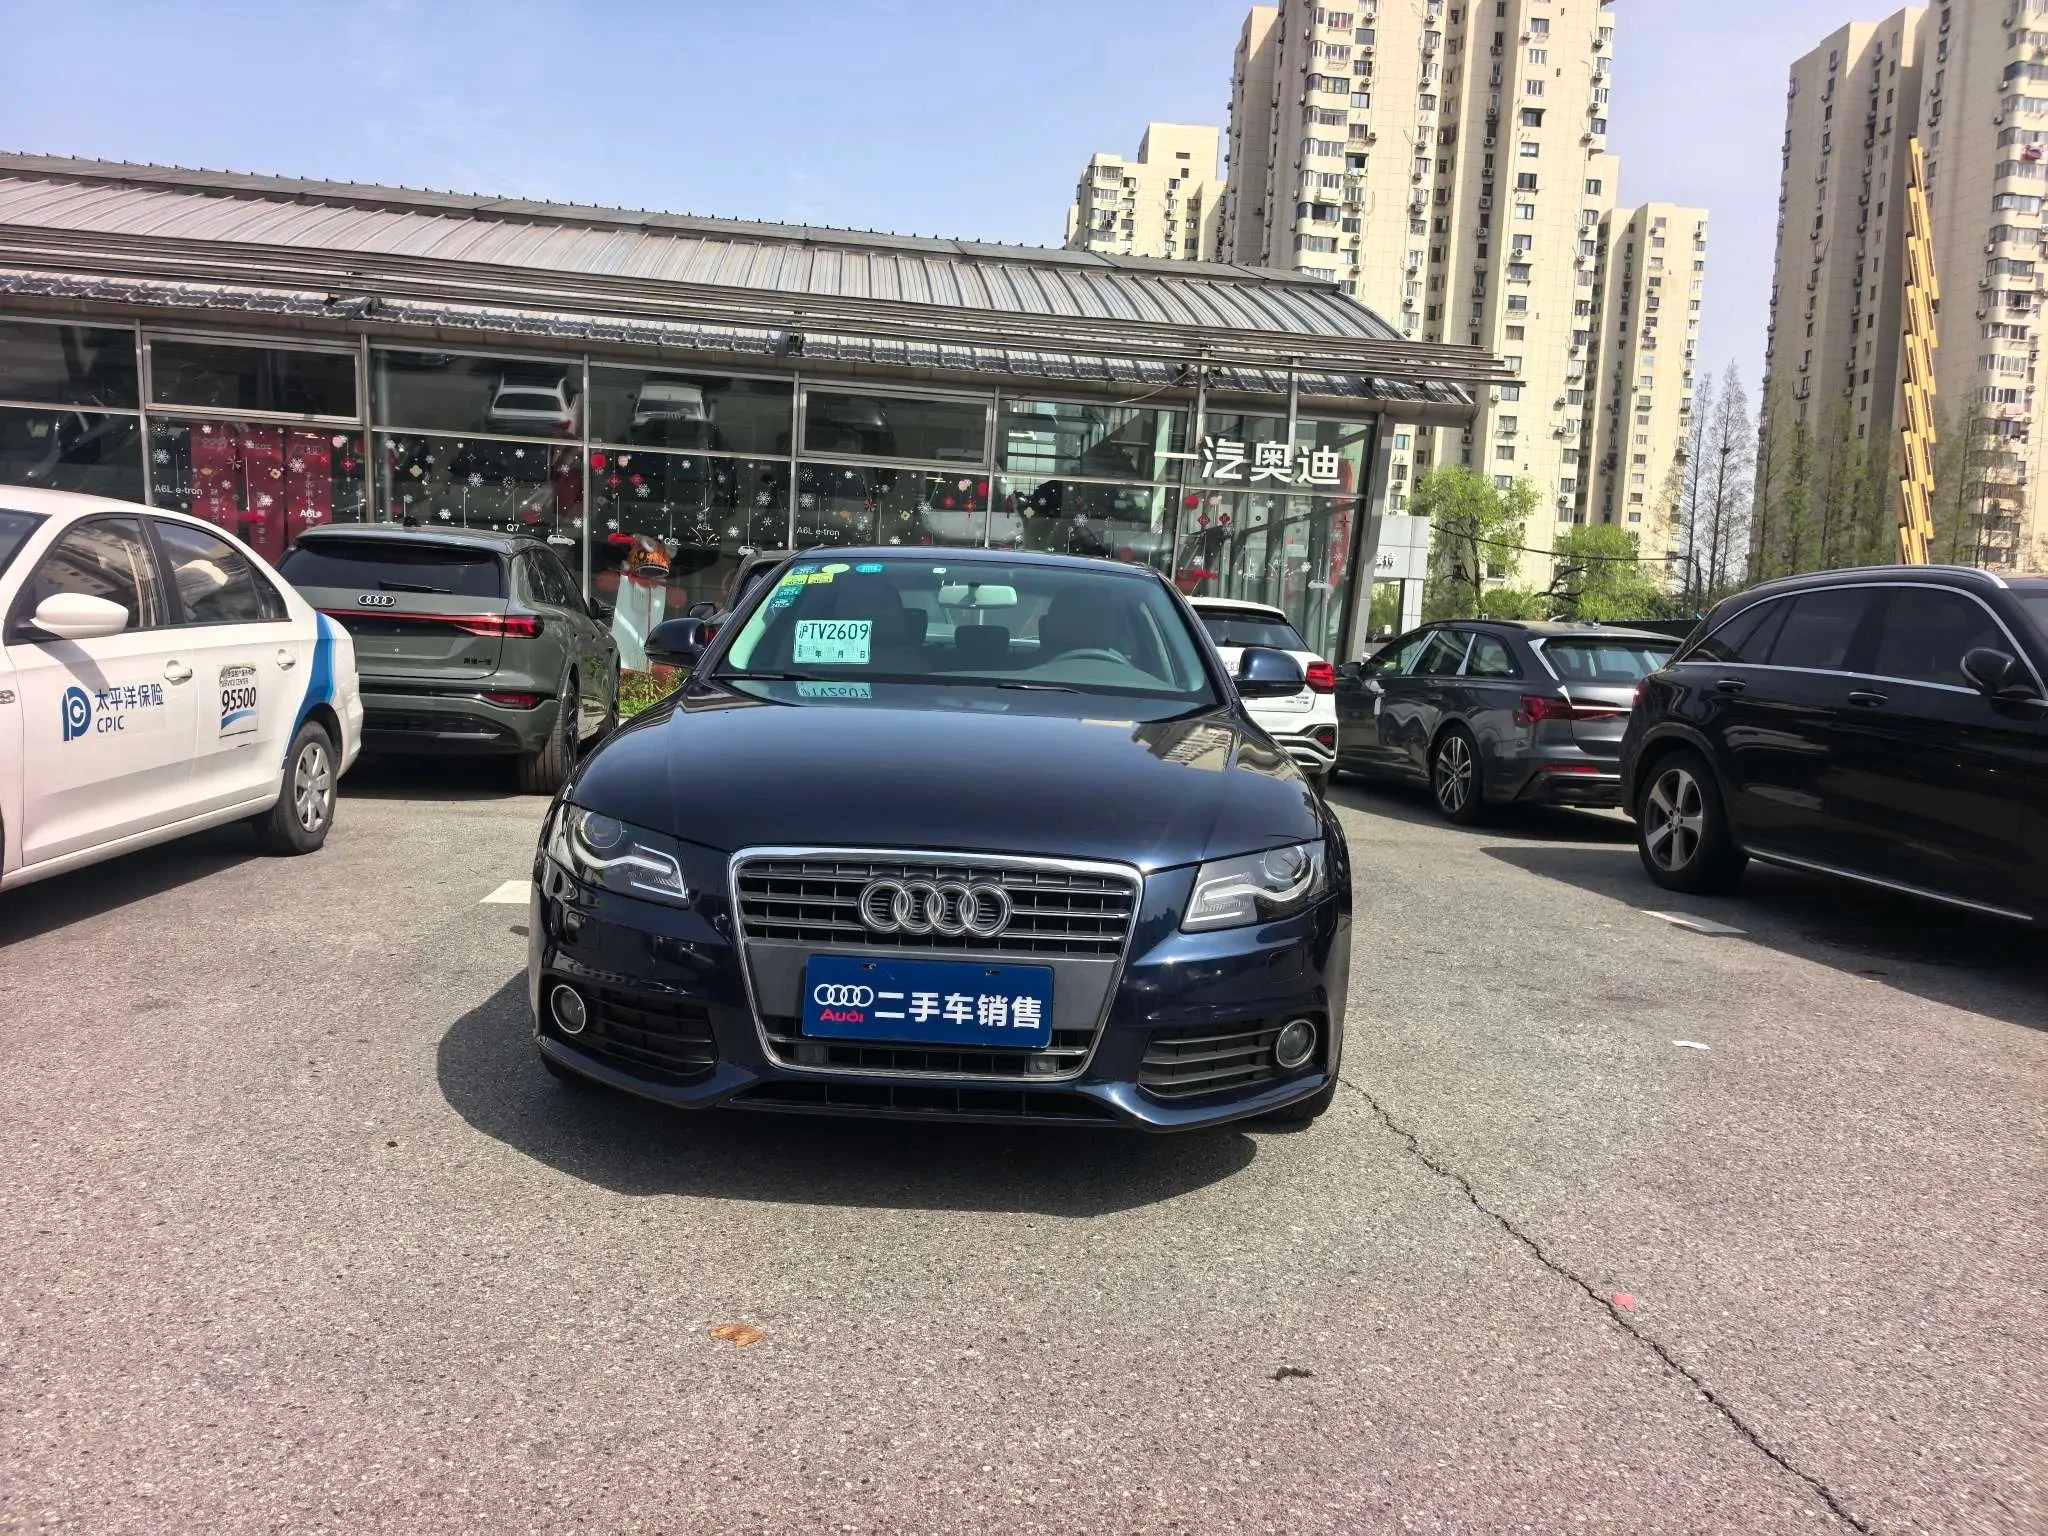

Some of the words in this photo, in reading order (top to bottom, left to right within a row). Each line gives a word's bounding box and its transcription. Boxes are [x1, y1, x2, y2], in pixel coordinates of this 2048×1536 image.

[1154, 435, 1341, 485] 一汽奥迪
[154, 484, 173, 494] A6L
[175, 486, 203, 496] e-tron
[299, 509, 317, 518] A6L
[506, 523, 520, 532] Q7
[798, 623, 869, 640] 沪TV2609
[95, 683, 164, 712] 太平洋保险
[221, 686, 257, 717] 95500
[96, 715, 125, 733] CPIC
[819, 1008, 864, 1023] Audi
[874, 992, 1042, 1029] 二手车销售
